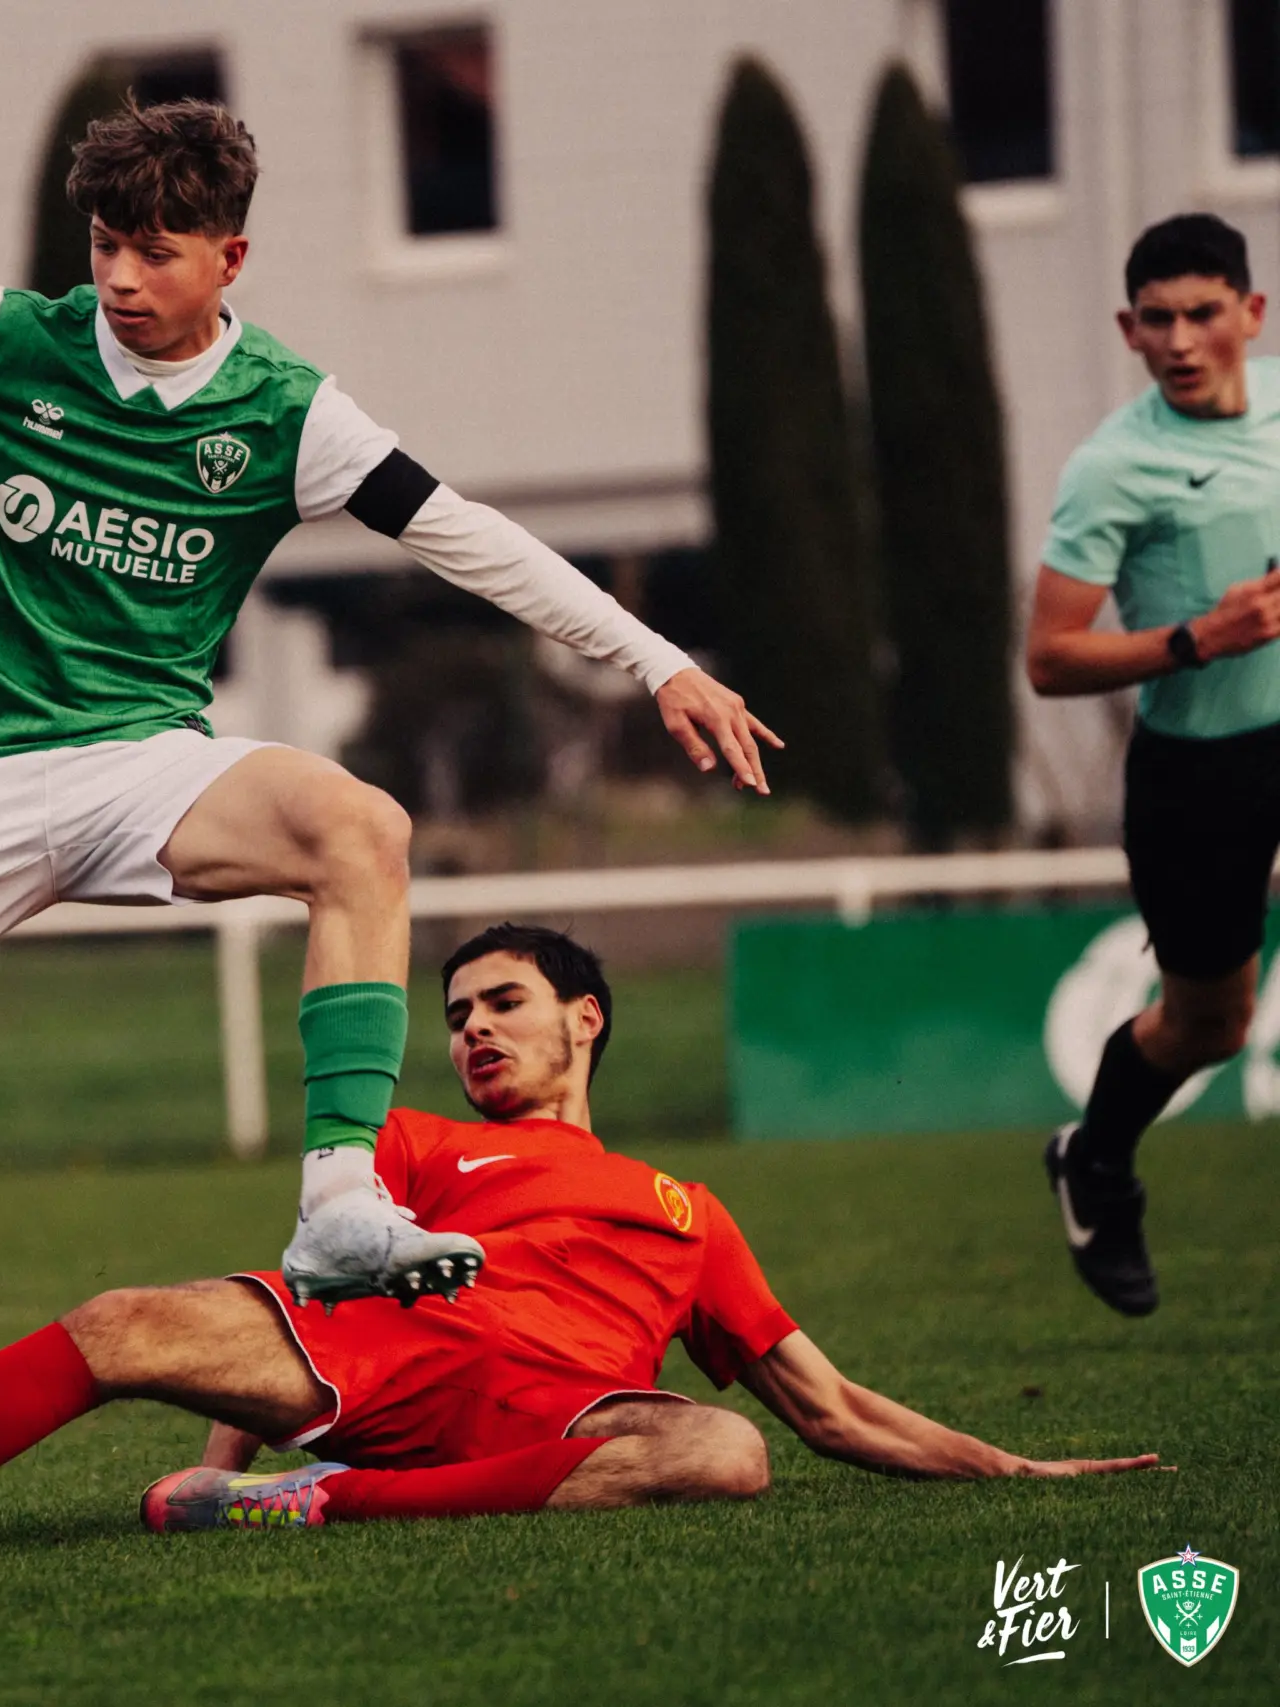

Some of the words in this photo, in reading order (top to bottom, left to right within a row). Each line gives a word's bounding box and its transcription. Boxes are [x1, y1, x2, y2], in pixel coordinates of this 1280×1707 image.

[22, 416, 64, 441] hummel
[203, 443, 243, 461] ASSE
[54, 500, 215, 563] AÉSIO
[50, 537, 198, 584] MUTUELLE
